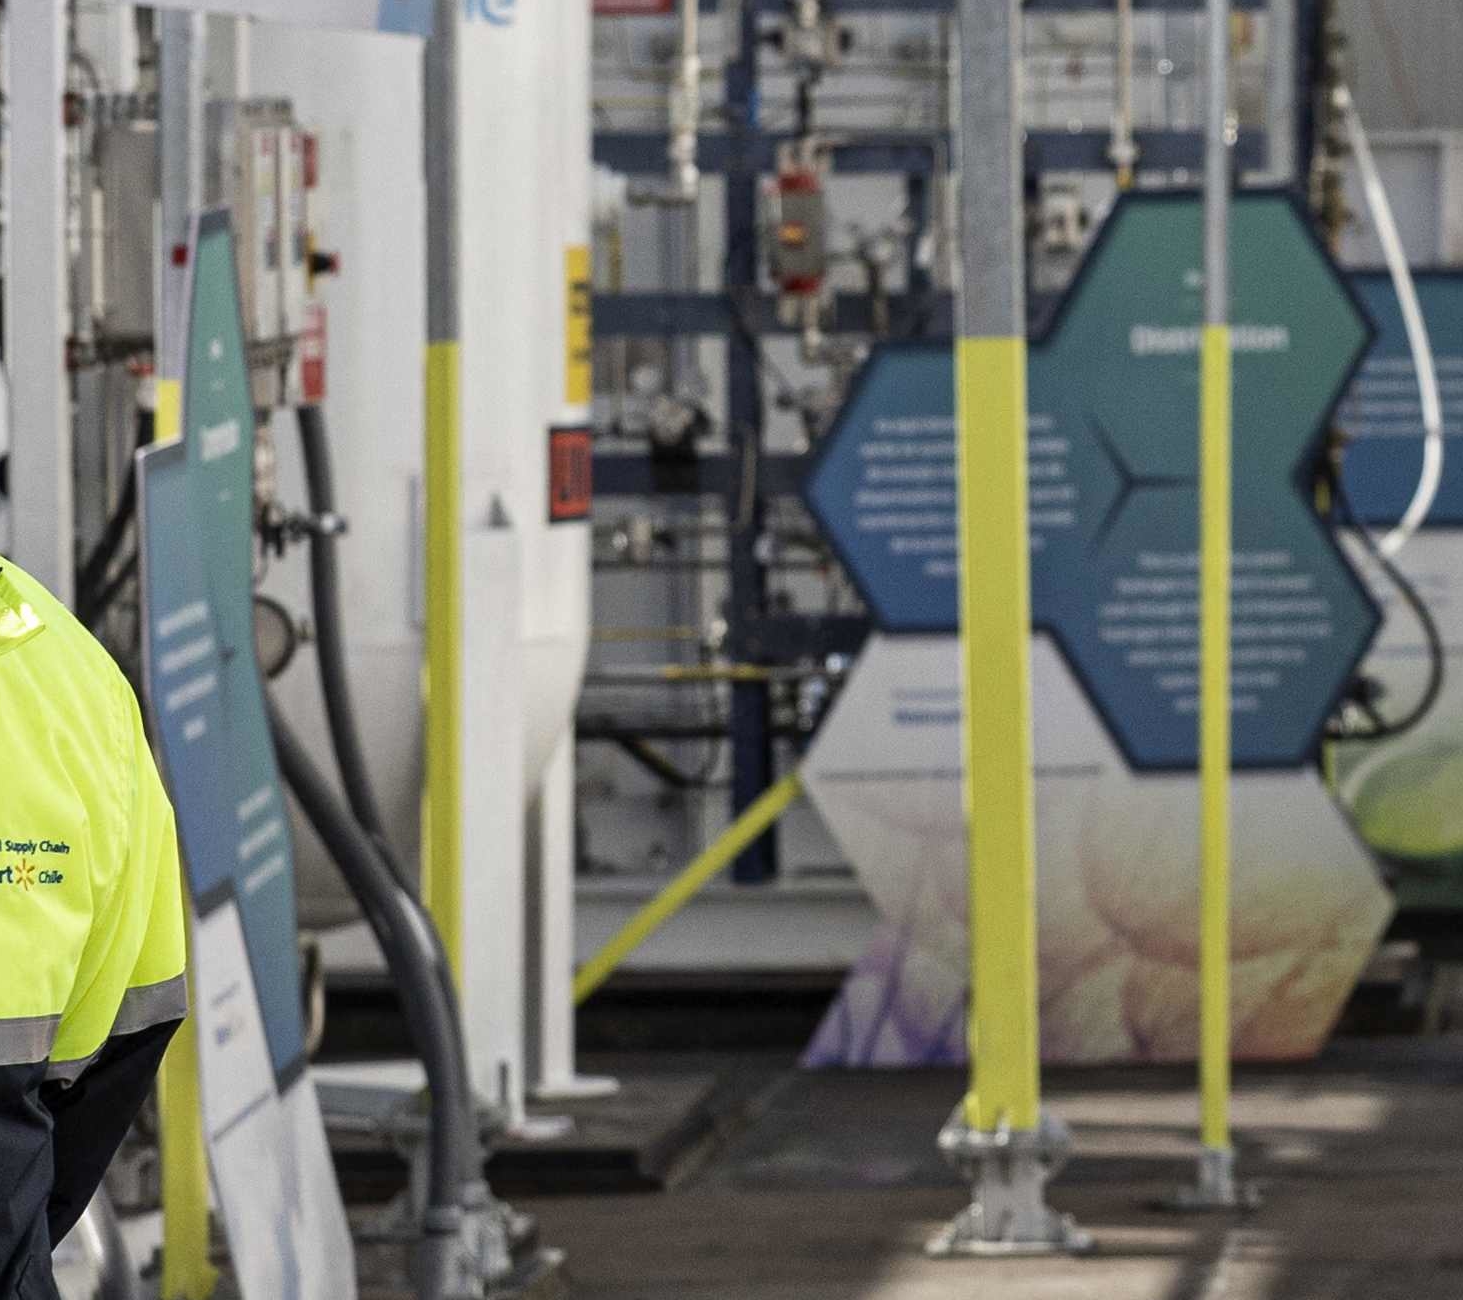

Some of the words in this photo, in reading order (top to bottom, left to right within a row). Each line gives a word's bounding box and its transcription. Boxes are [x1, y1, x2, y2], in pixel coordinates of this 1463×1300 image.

[5, 839, 38, 855] Supply
[38, 840, 71, 854] Chain
[38, 870, 64, 884] Chile
